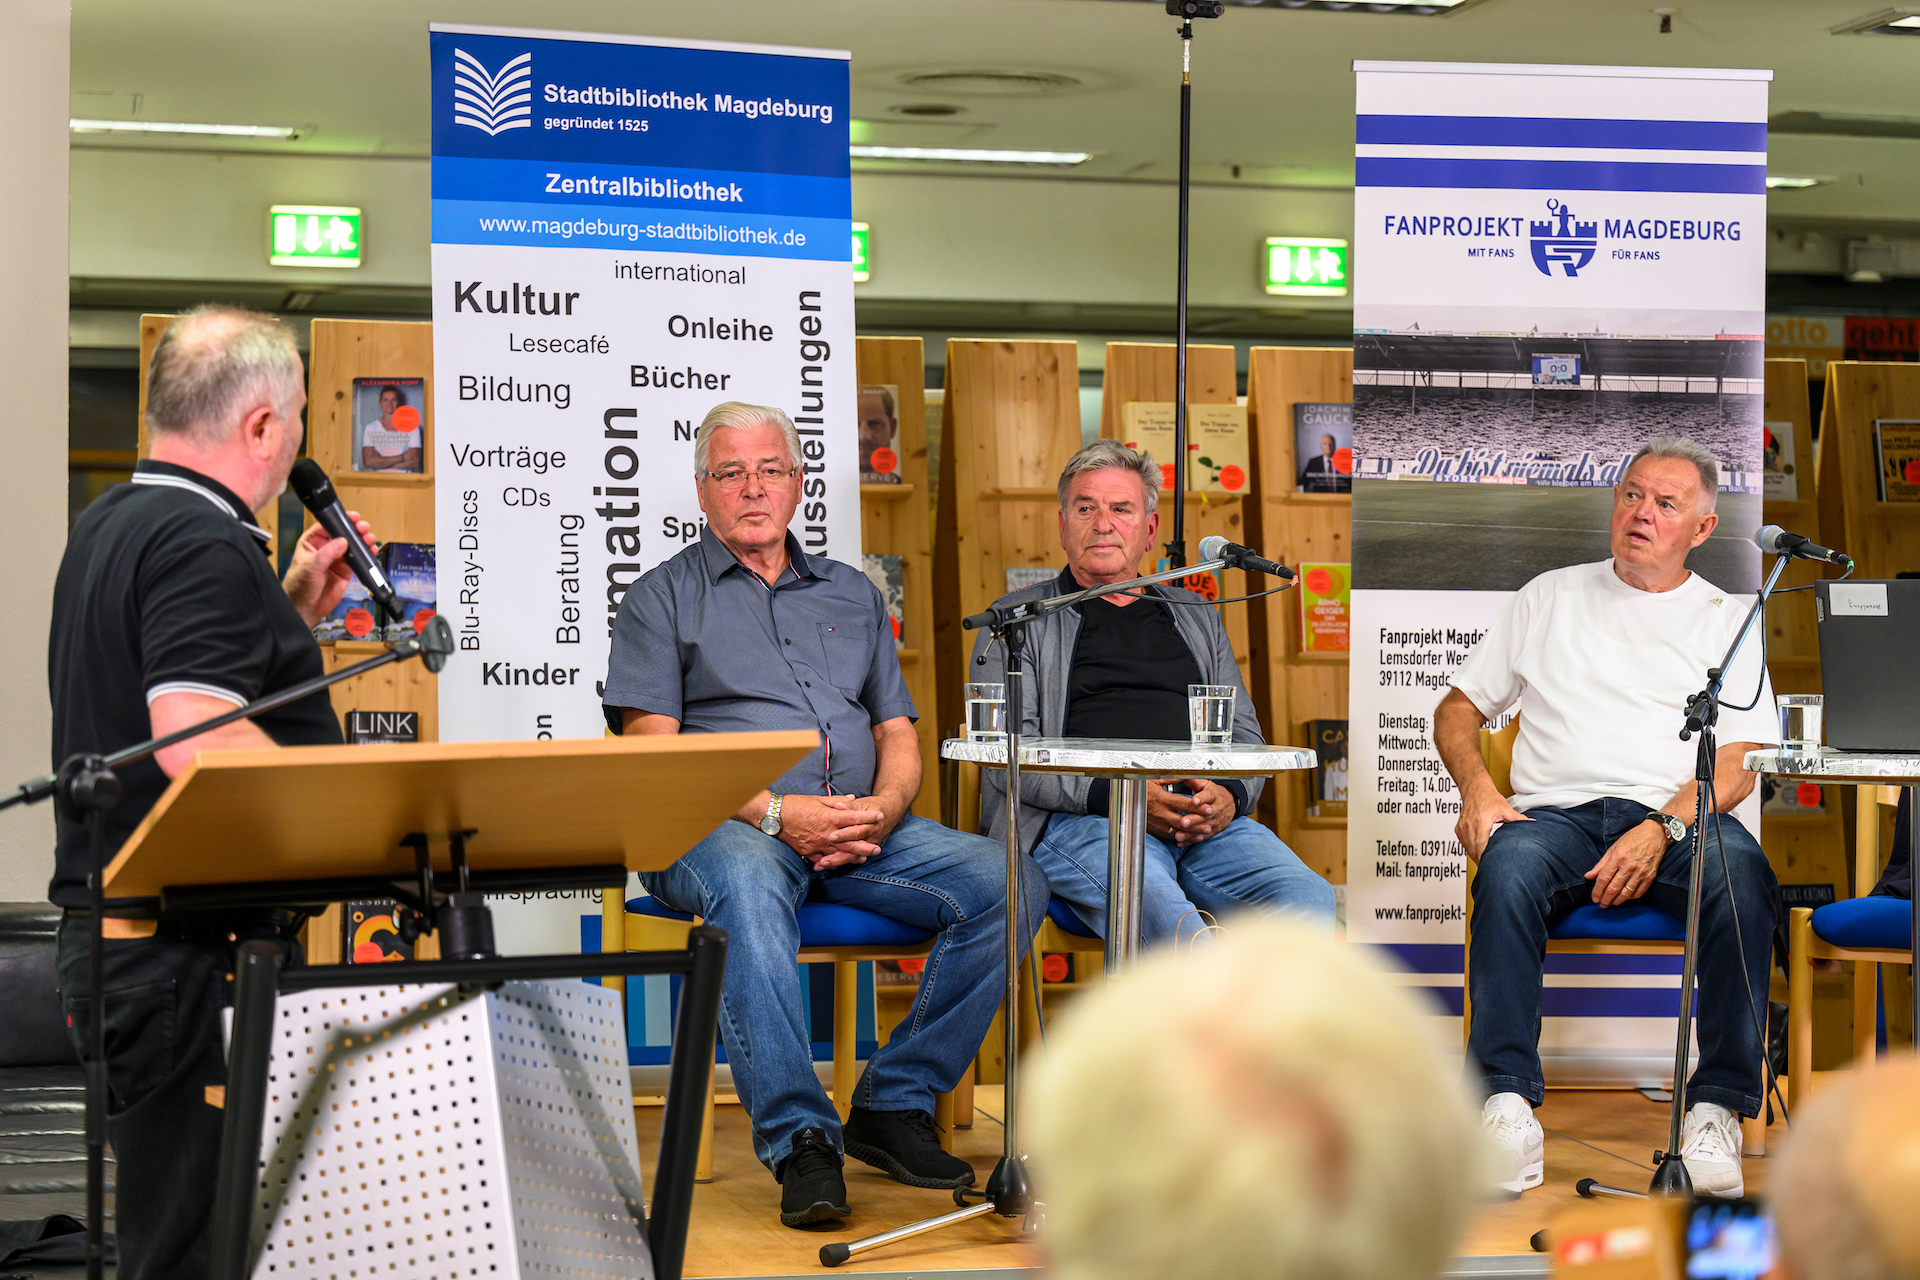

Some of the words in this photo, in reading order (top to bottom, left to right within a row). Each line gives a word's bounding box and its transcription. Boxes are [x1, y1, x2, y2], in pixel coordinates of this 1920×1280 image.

[544, 83, 708, 112] Stadtbibliothek
[714, 94, 833, 124] Magdeburg
[544, 115, 613, 133] gegründet
[617, 119, 649, 132] 1525
[545, 173, 743, 202] Zentralbibliothek
[479, 217, 806, 247] www.magdeburg-stadtbibliothek.de
[1385, 215, 1524, 238] FANPROJEKT
[1604, 218, 1741, 241] MAGDEBURG
[1468, 247, 1486, 257] MIT
[1488, 248, 1515, 258] FANS
[1612, 249, 1632, 260] FÜR
[1634, 251, 1660, 261] FANS
[615, 261, 746, 284] international
[454, 281, 580, 315] Kultur
[667, 315, 774, 341] Onleihe
[509, 333, 610, 354] Lesecafé
[630, 364, 731, 390] Bücher
[459, 375, 571, 409] Bildung
[794, 290, 830, 557] usstellungen
[1302, 413, 1351, 425] GAUCK
[450, 443, 566, 474] Vorträge
[1411, 448, 1452, 475] Du
[1456, 450, 1505, 477] bist
[1505, 452, 1595, 481] niemals
[1601, 454, 1634, 481] al
[502, 487, 551, 507] CDs
[459, 489, 484, 651] Blu-Ray-Discs
[555, 513, 585, 644] Beratung
[1380, 627, 1442, 648] Fanprojekt
[1380, 649, 1442, 665] Lemsdorfer
[1446, 650, 1468, 665] We
[482, 662, 580, 687] Kinder
[1379, 670, 1411, 686] 39112
[1415, 671, 1454, 690] Magde
[355, 713, 413, 734] LINK
[1379, 712, 1429, 732] Dienstag:
[1322, 729, 1348, 744] CA
[1378, 734, 1431, 750] Mittwoch:
[1378, 755, 1443, 775] Donnerstag:
[1377, 777, 1418, 796] Freitag:
[1422, 777, 1458, 793] 14.00-
[1377, 798, 1402, 814] oder
[1405, 798, 1431, 814] nach
[1376, 840, 1418, 856] Telefon:
[1376, 861, 1402, 877] Mail:
[1405, 861, 1467, 882] fanprojekt-
[1375, 904, 1466, 924] www.fanprojekt-
